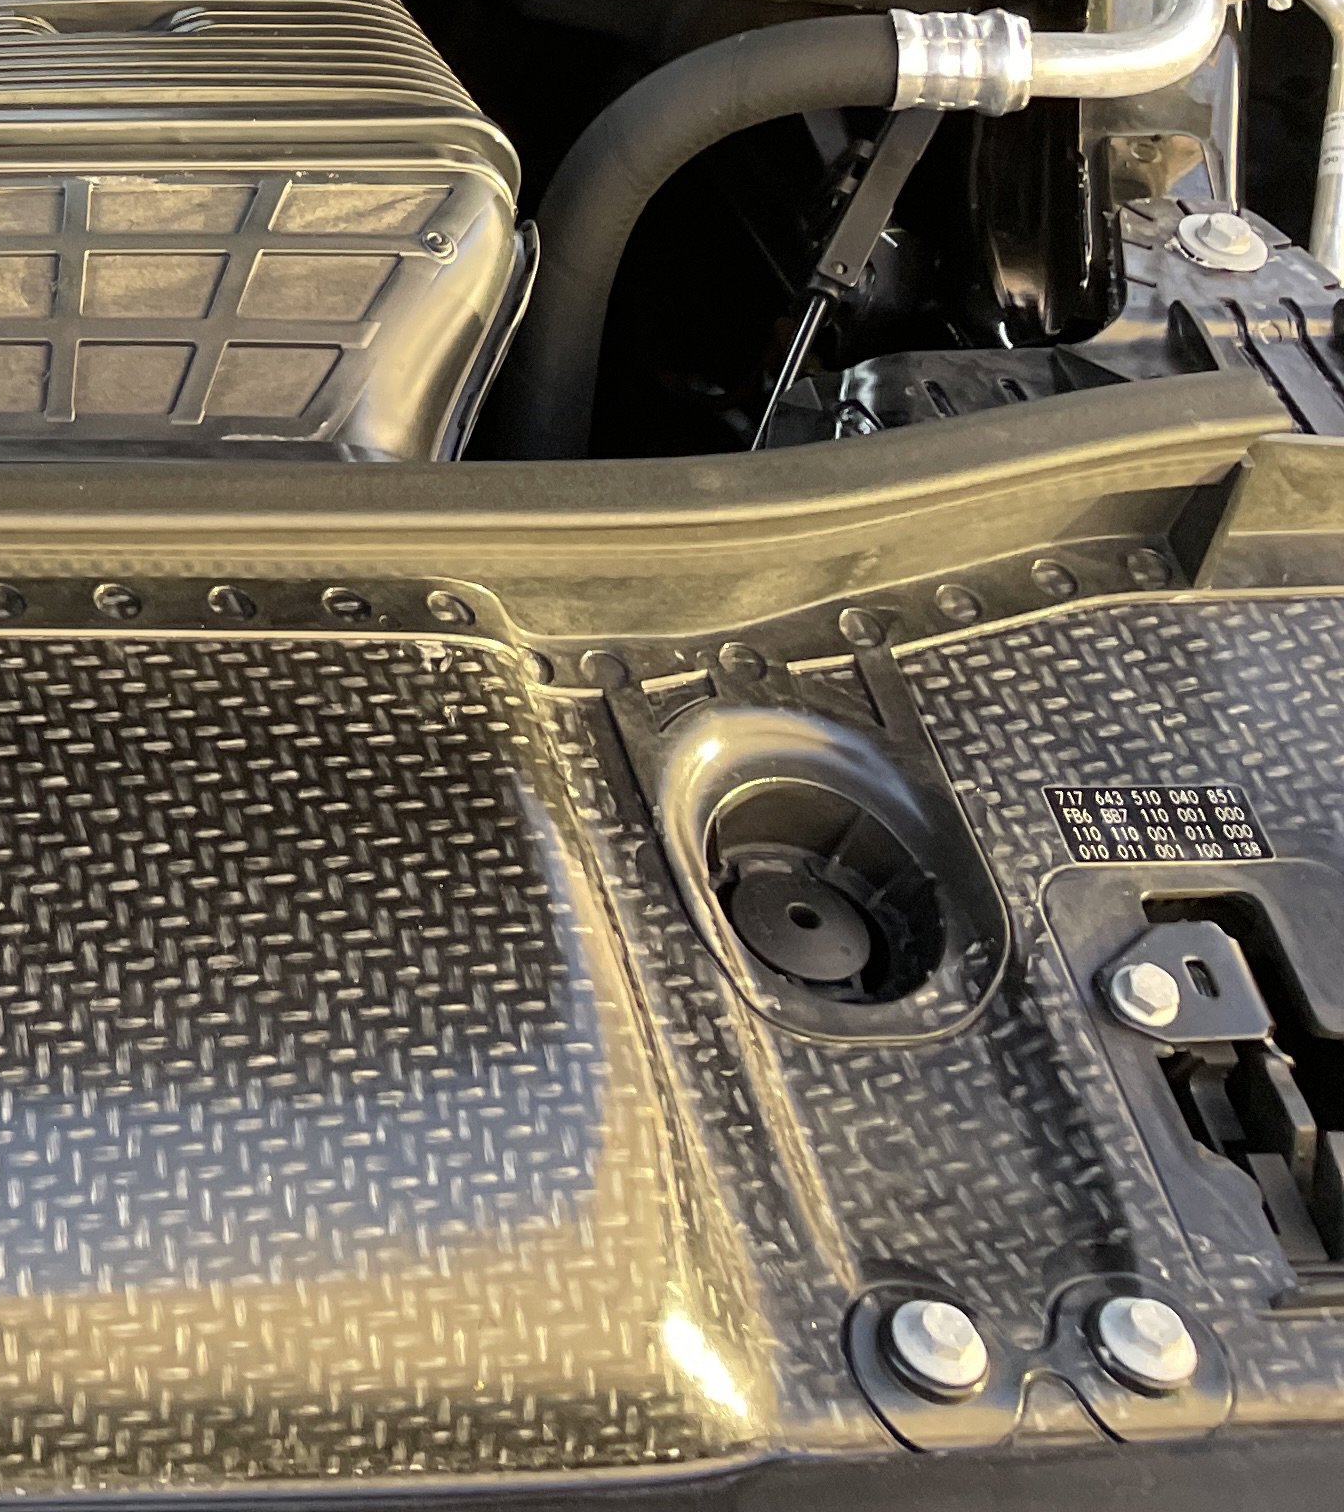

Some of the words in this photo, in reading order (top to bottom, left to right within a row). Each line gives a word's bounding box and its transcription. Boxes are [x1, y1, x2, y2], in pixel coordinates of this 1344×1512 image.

[1055, 790, 1083, 806] 717
[1095, 790, 1124, 805] 643
[1131, 790, 1162, 805] 510
[1169, 789, 1199, 805] 040
[1206, 789, 1237, 804] 851
[1062, 807, 1093, 823] FB6
[1100, 807, 1128, 823] BB7
[1140, 807, 1169, 823] 110
[1176, 807, 1207, 822] 001
[1214, 806, 1245, 822] 000
[1072, 826, 1102, 841] 110
[1110, 826, 1140, 841] 110
[1146, 825, 1177, 841] 001
[1184, 825, 1215, 840] 011
[1222, 824, 1254, 839] 000
[1078, 844, 1110, 859] 010
[1117, 844, 1147, 859] 011
[1155, 843, 1185, 858] 001
[1195, 843, 1224, 858] 100
[1232, 842, 1262, 857] 138
